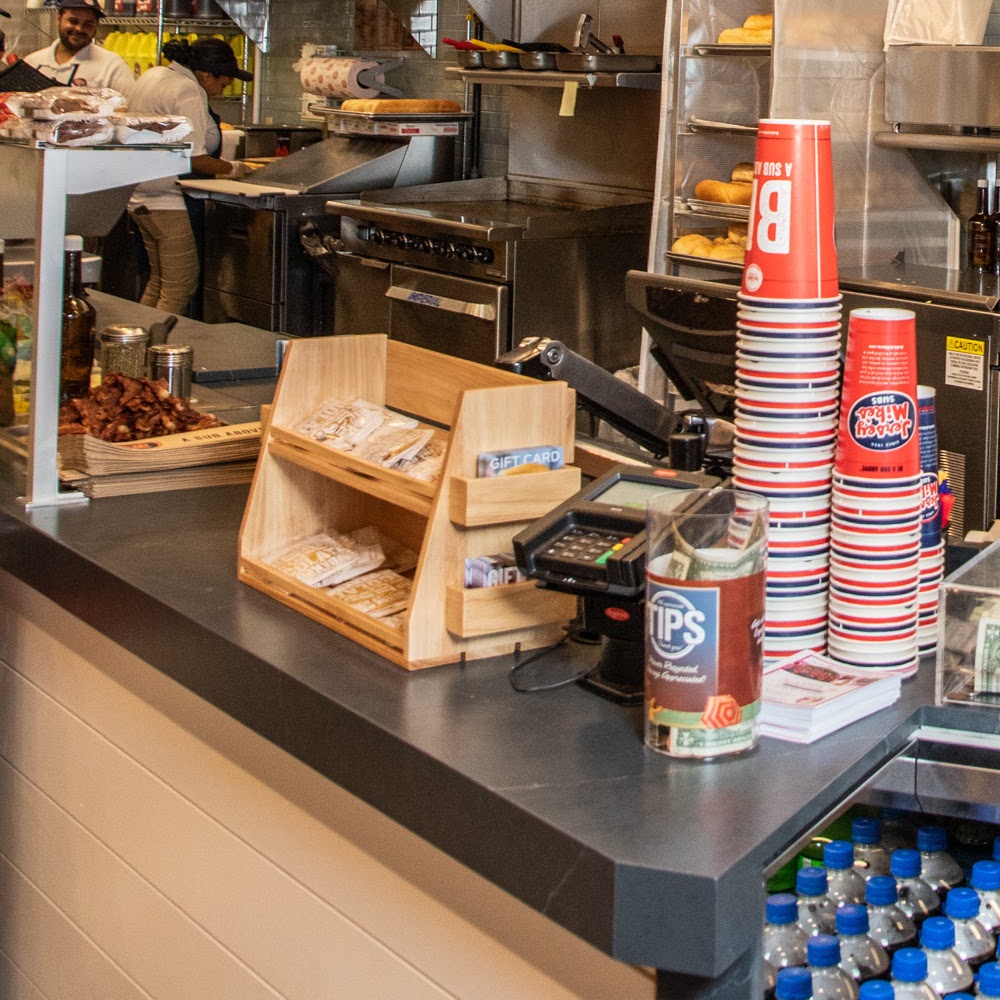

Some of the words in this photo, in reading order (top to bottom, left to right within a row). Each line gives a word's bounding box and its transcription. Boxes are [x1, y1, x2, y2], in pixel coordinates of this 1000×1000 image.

[954, 340, 983, 352] CAUTION
[871, 395, 895, 405] SUBS
[856, 402, 909, 423] Mike's
[855, 419, 912, 439] Jersey
[490, 452, 519, 470] GIFT
[523, 450, 560, 464] CARD
[646, 601, 705, 645] TIPS
